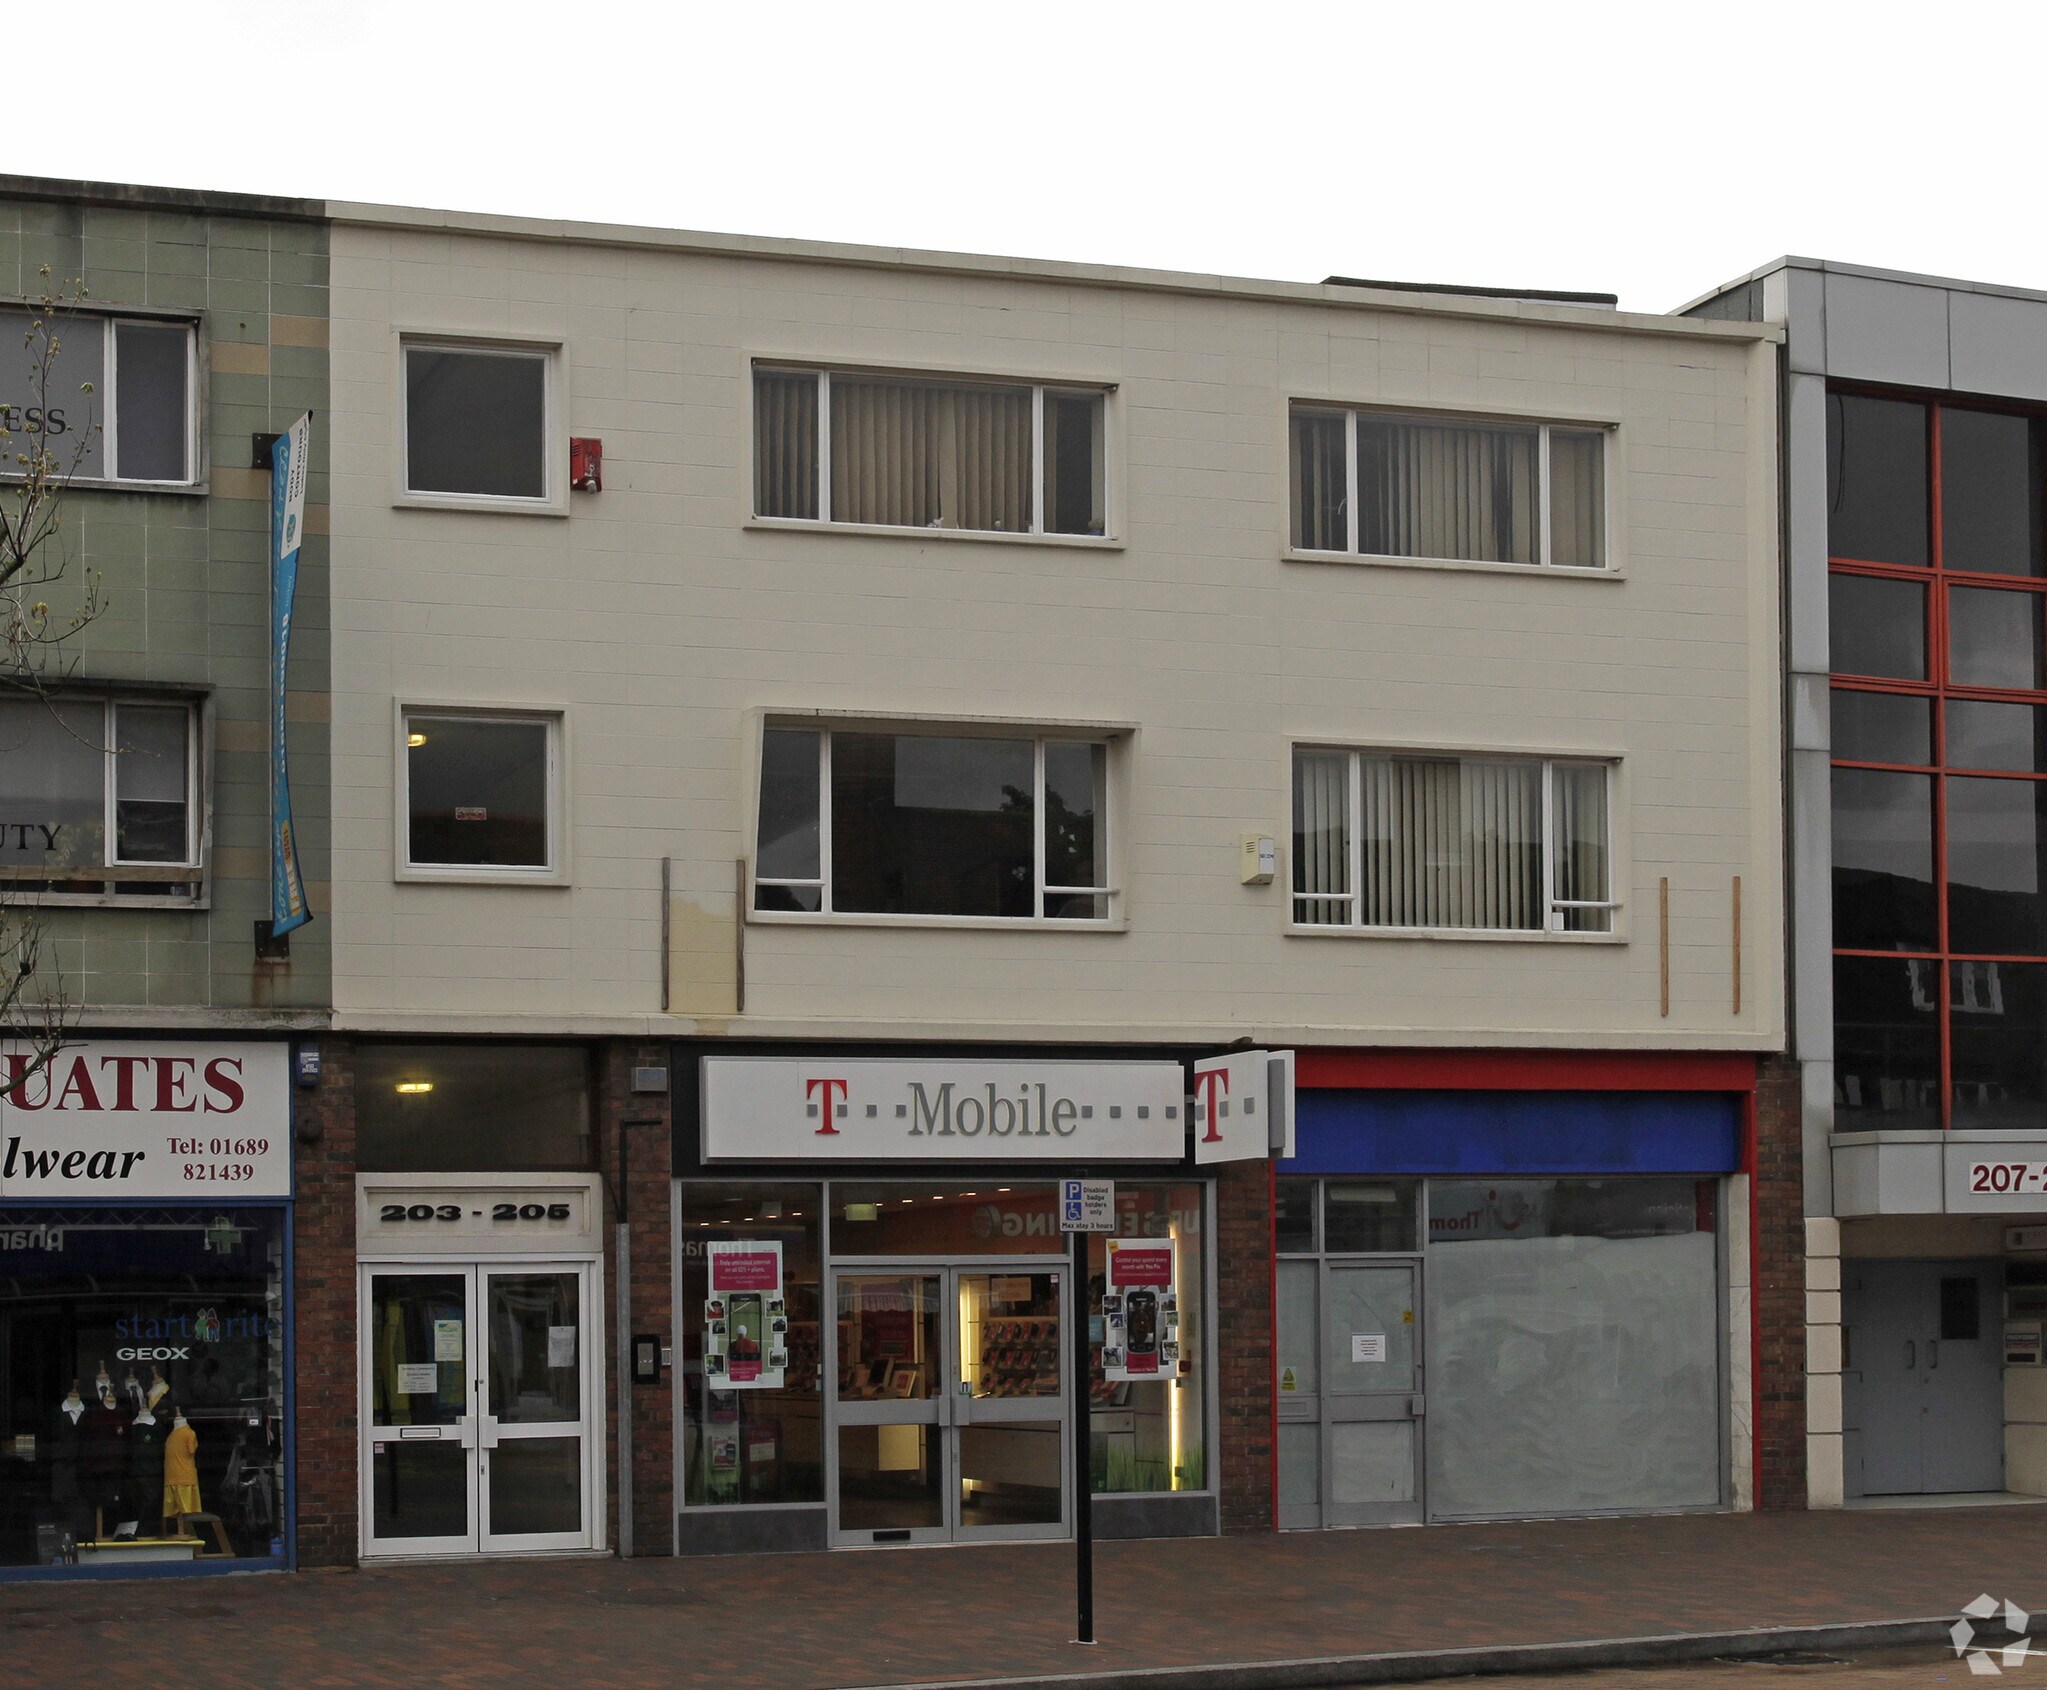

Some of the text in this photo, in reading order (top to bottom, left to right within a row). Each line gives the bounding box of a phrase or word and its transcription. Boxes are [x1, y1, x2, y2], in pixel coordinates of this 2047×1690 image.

[295, 427, 303, 498] CONTOURS
[907, 1082, 1077, 1137] Mobile
[1195, 1068, 1230, 1143] T
[167, 1138, 269, 1156] Tel: 01689
[3, 1136, 145, 1179] lwear
[183, 1163, 254, 1181] 821439
[1973, 1164, 2047, 1192] 207-
[1069, 1183, 1080, 1199] P
[1087, 1194, 1105, 1202] badge
[380, 1204, 461, 1221] 203
[492, 1204, 570, 1221] 205
[1089, 1209, 1103, 1217] only
[1076, 1222, 1089, 1230] stay
[115, 1308, 281, 1341] start rite
[116, 1347, 190, 1361] GEOX
